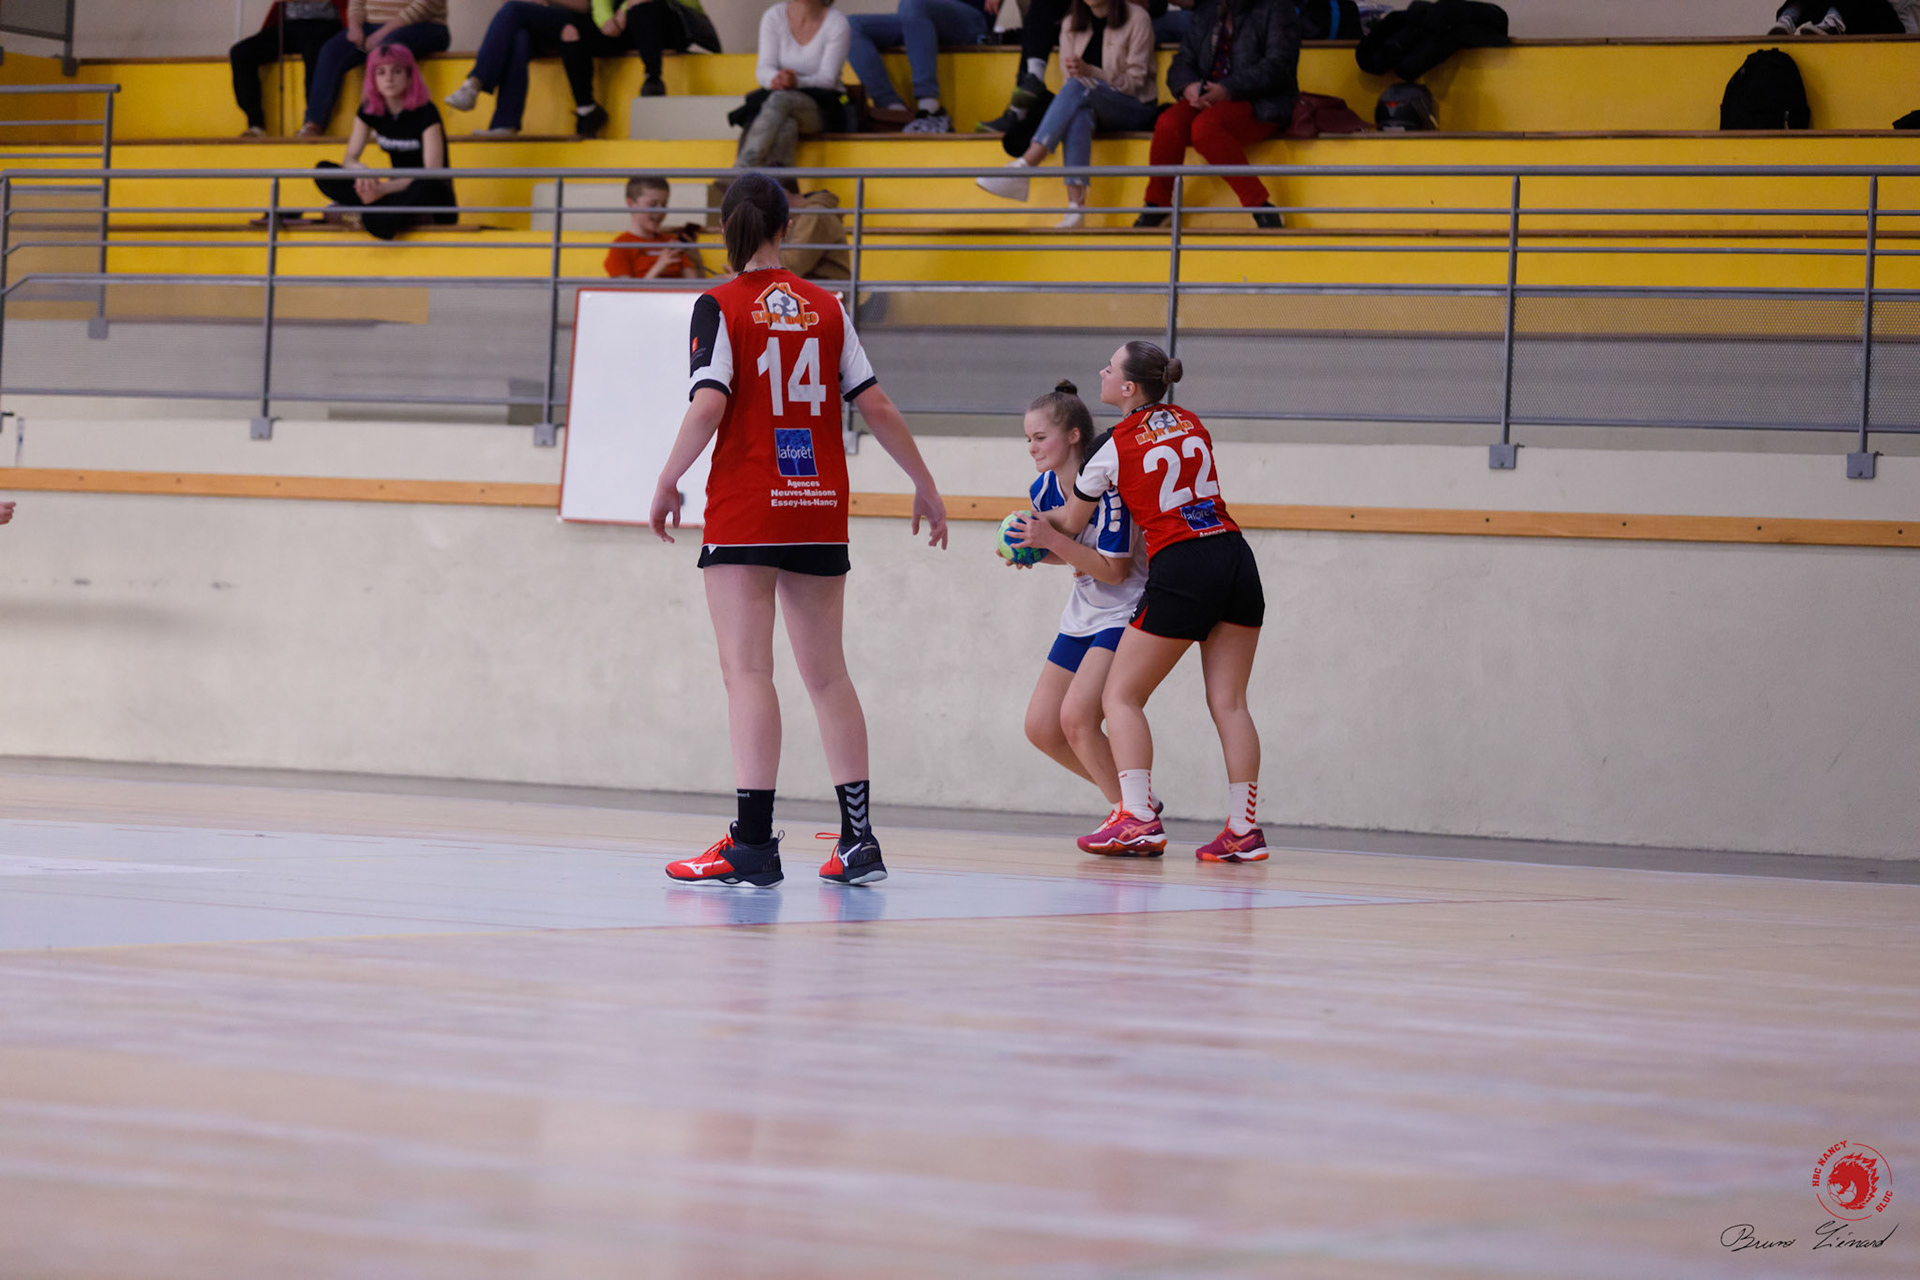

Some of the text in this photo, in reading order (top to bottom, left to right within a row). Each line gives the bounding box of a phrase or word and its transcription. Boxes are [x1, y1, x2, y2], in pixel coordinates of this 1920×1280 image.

[757, 337, 826, 416] 14
[777, 445, 813, 459] laforêt
[1143, 436, 1219, 513] 22
[787, 479, 820, 488] Agences
[771, 489, 836, 497] Neuves-Maisons
